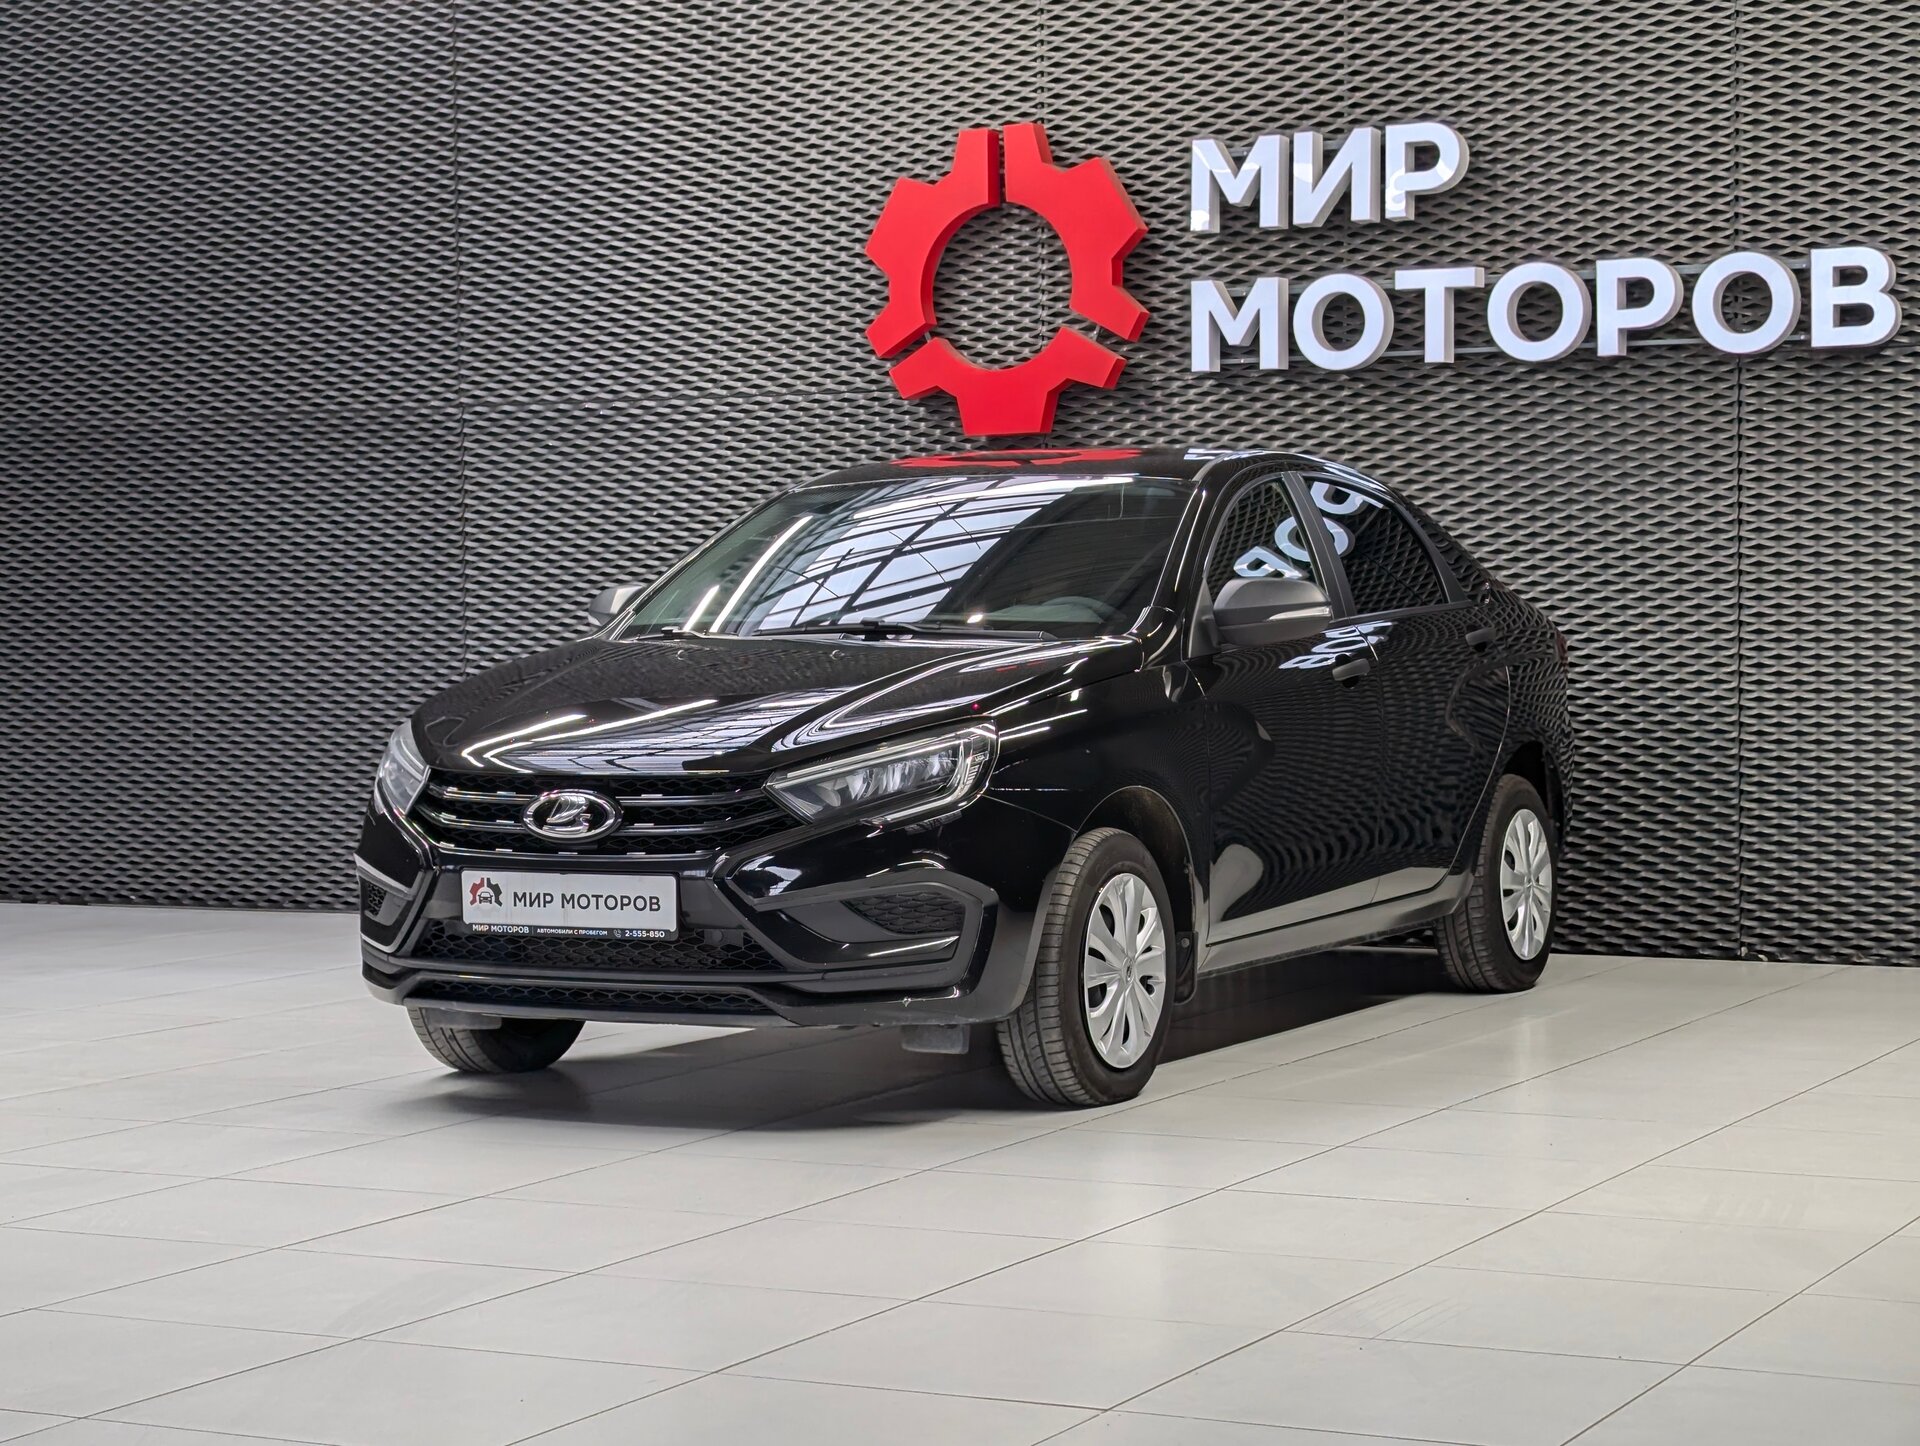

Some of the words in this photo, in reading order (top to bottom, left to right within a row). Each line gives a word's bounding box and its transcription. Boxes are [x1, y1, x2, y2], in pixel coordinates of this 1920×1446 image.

[1190, 121, 1470, 233] МИР
[1190, 246, 1902, 373] МОТОРОВ
[490, 925, 529, 934] МОТОРОВ
[625, 930, 665, 938] 2-555-850
[513, 891, 554, 908] МИР
[561, 893, 661, 912] МОТОРОВ
